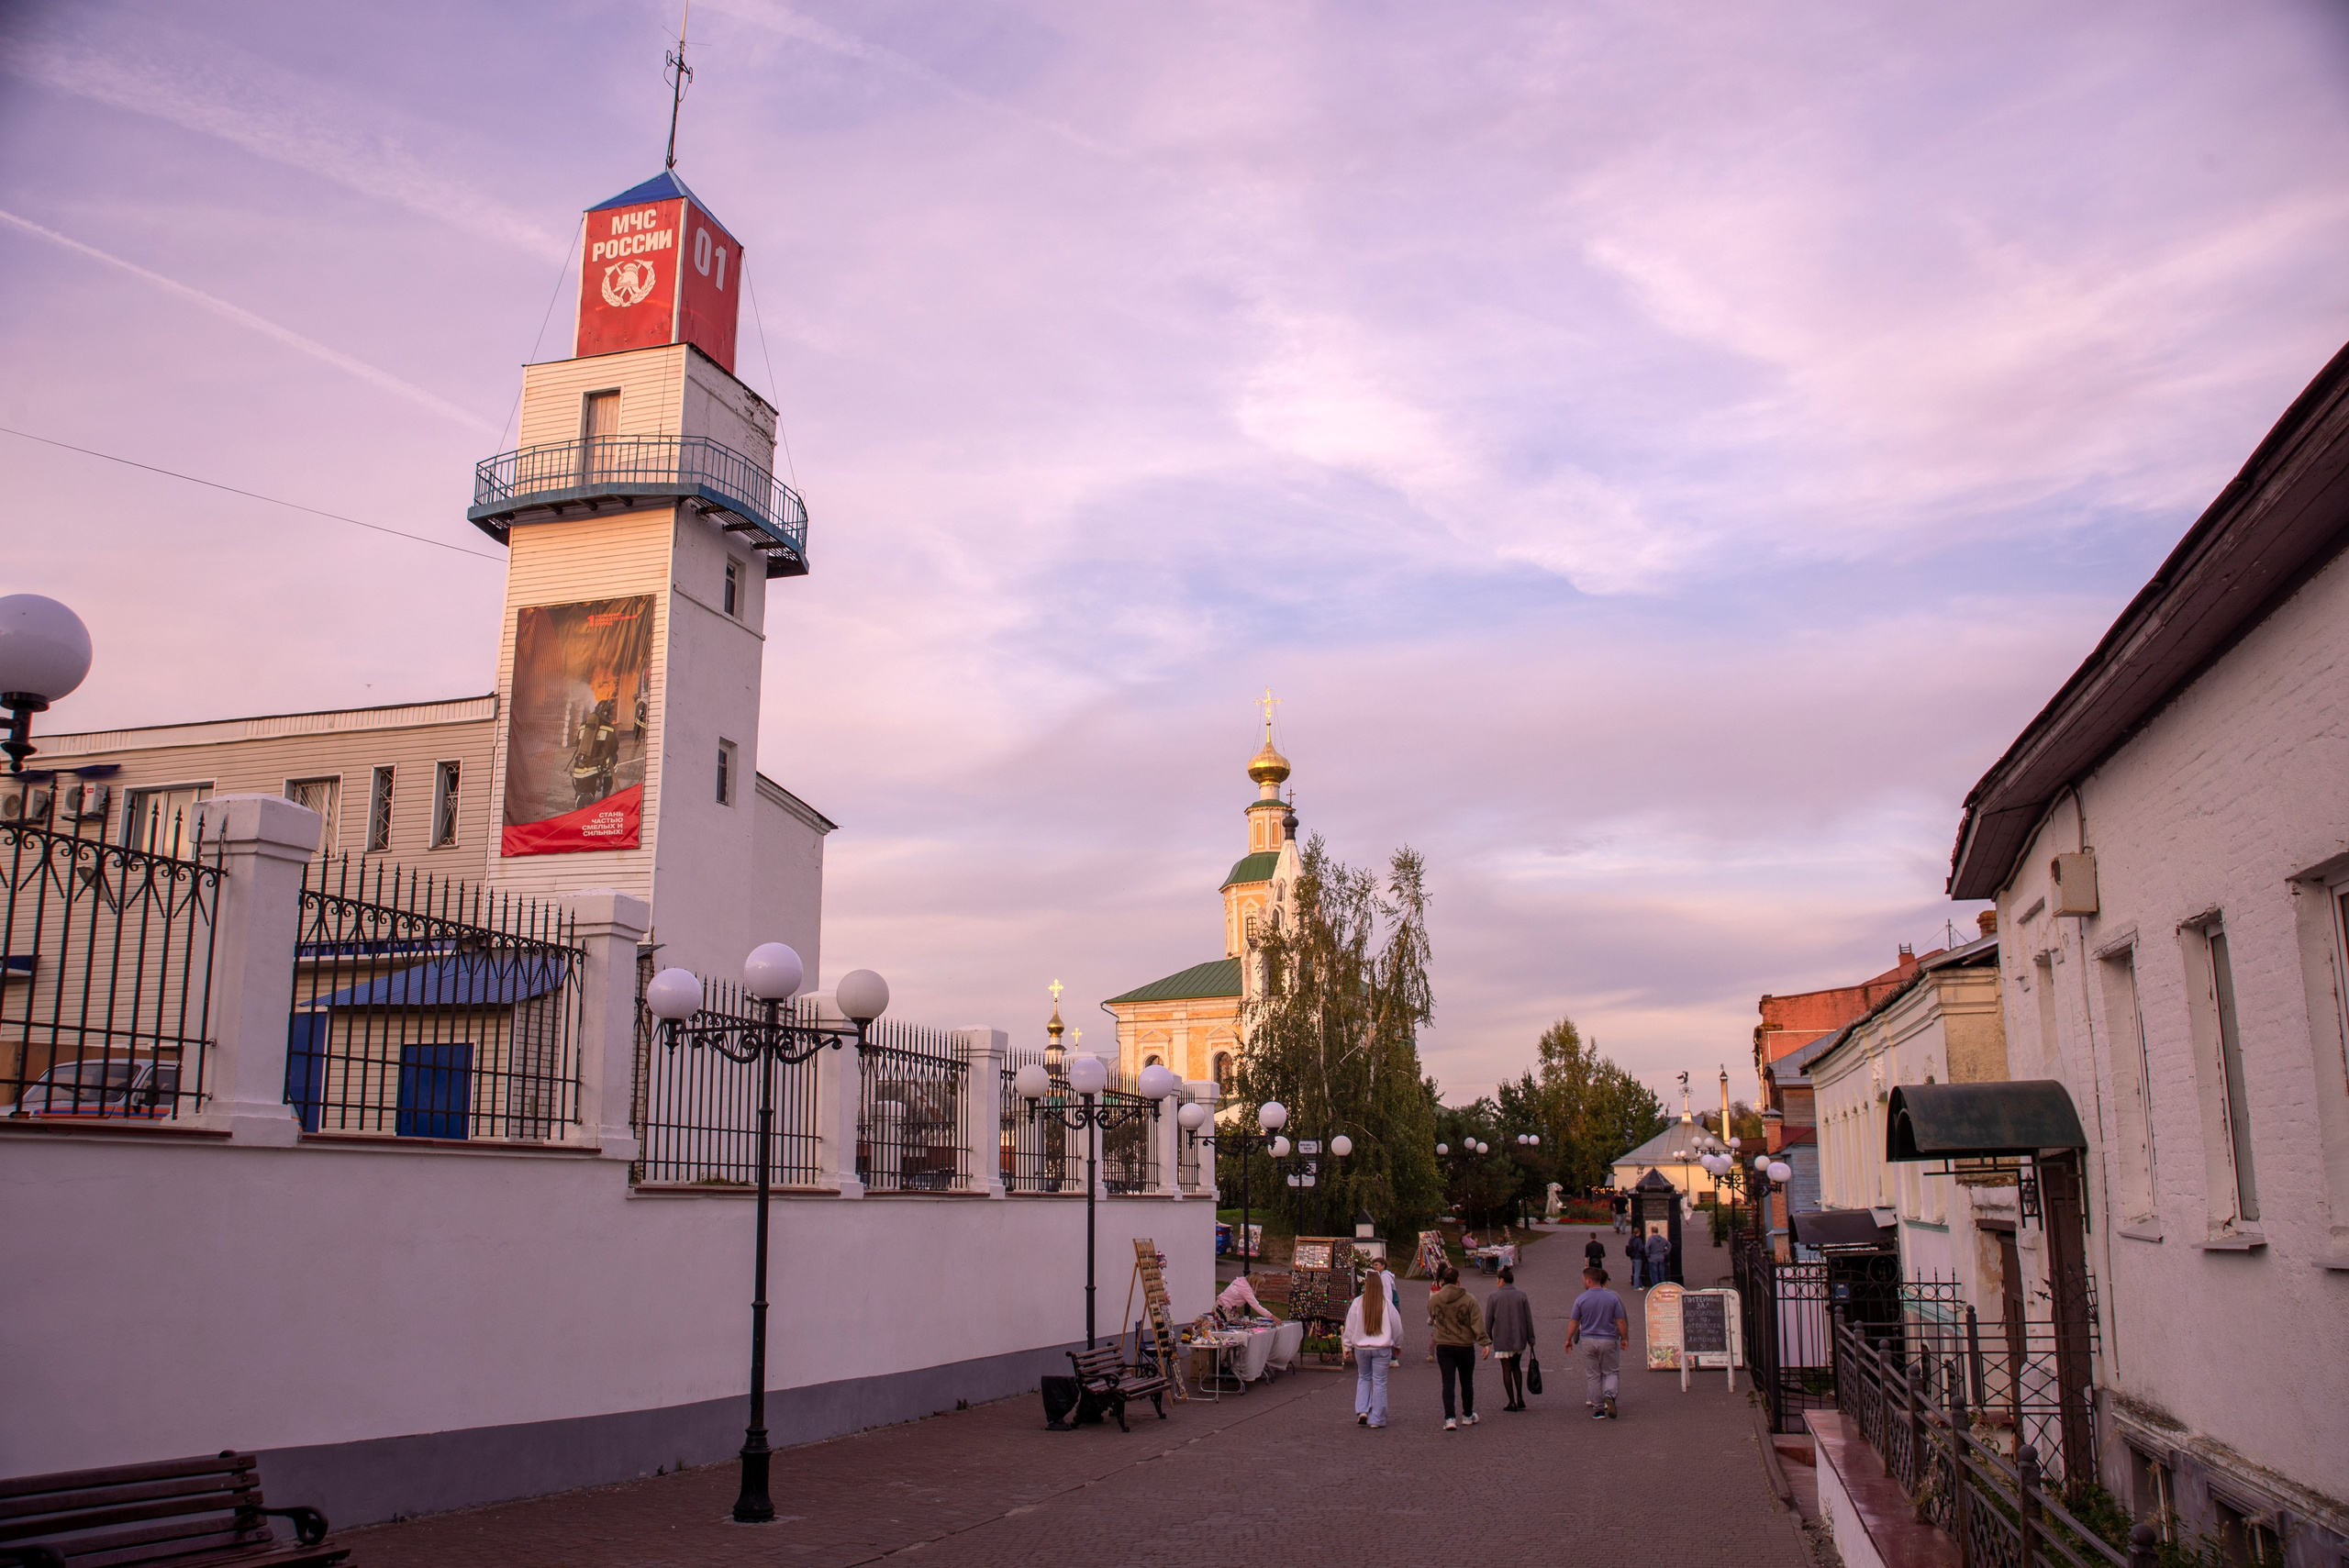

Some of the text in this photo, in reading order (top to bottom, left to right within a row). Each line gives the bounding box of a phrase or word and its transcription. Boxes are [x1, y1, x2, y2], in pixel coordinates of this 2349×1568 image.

[611, 208, 657, 236] МЧС
[592, 228, 673, 262] РОССИИ
[694, 227, 727, 292] 01
[587, 615, 595, 627] 1
